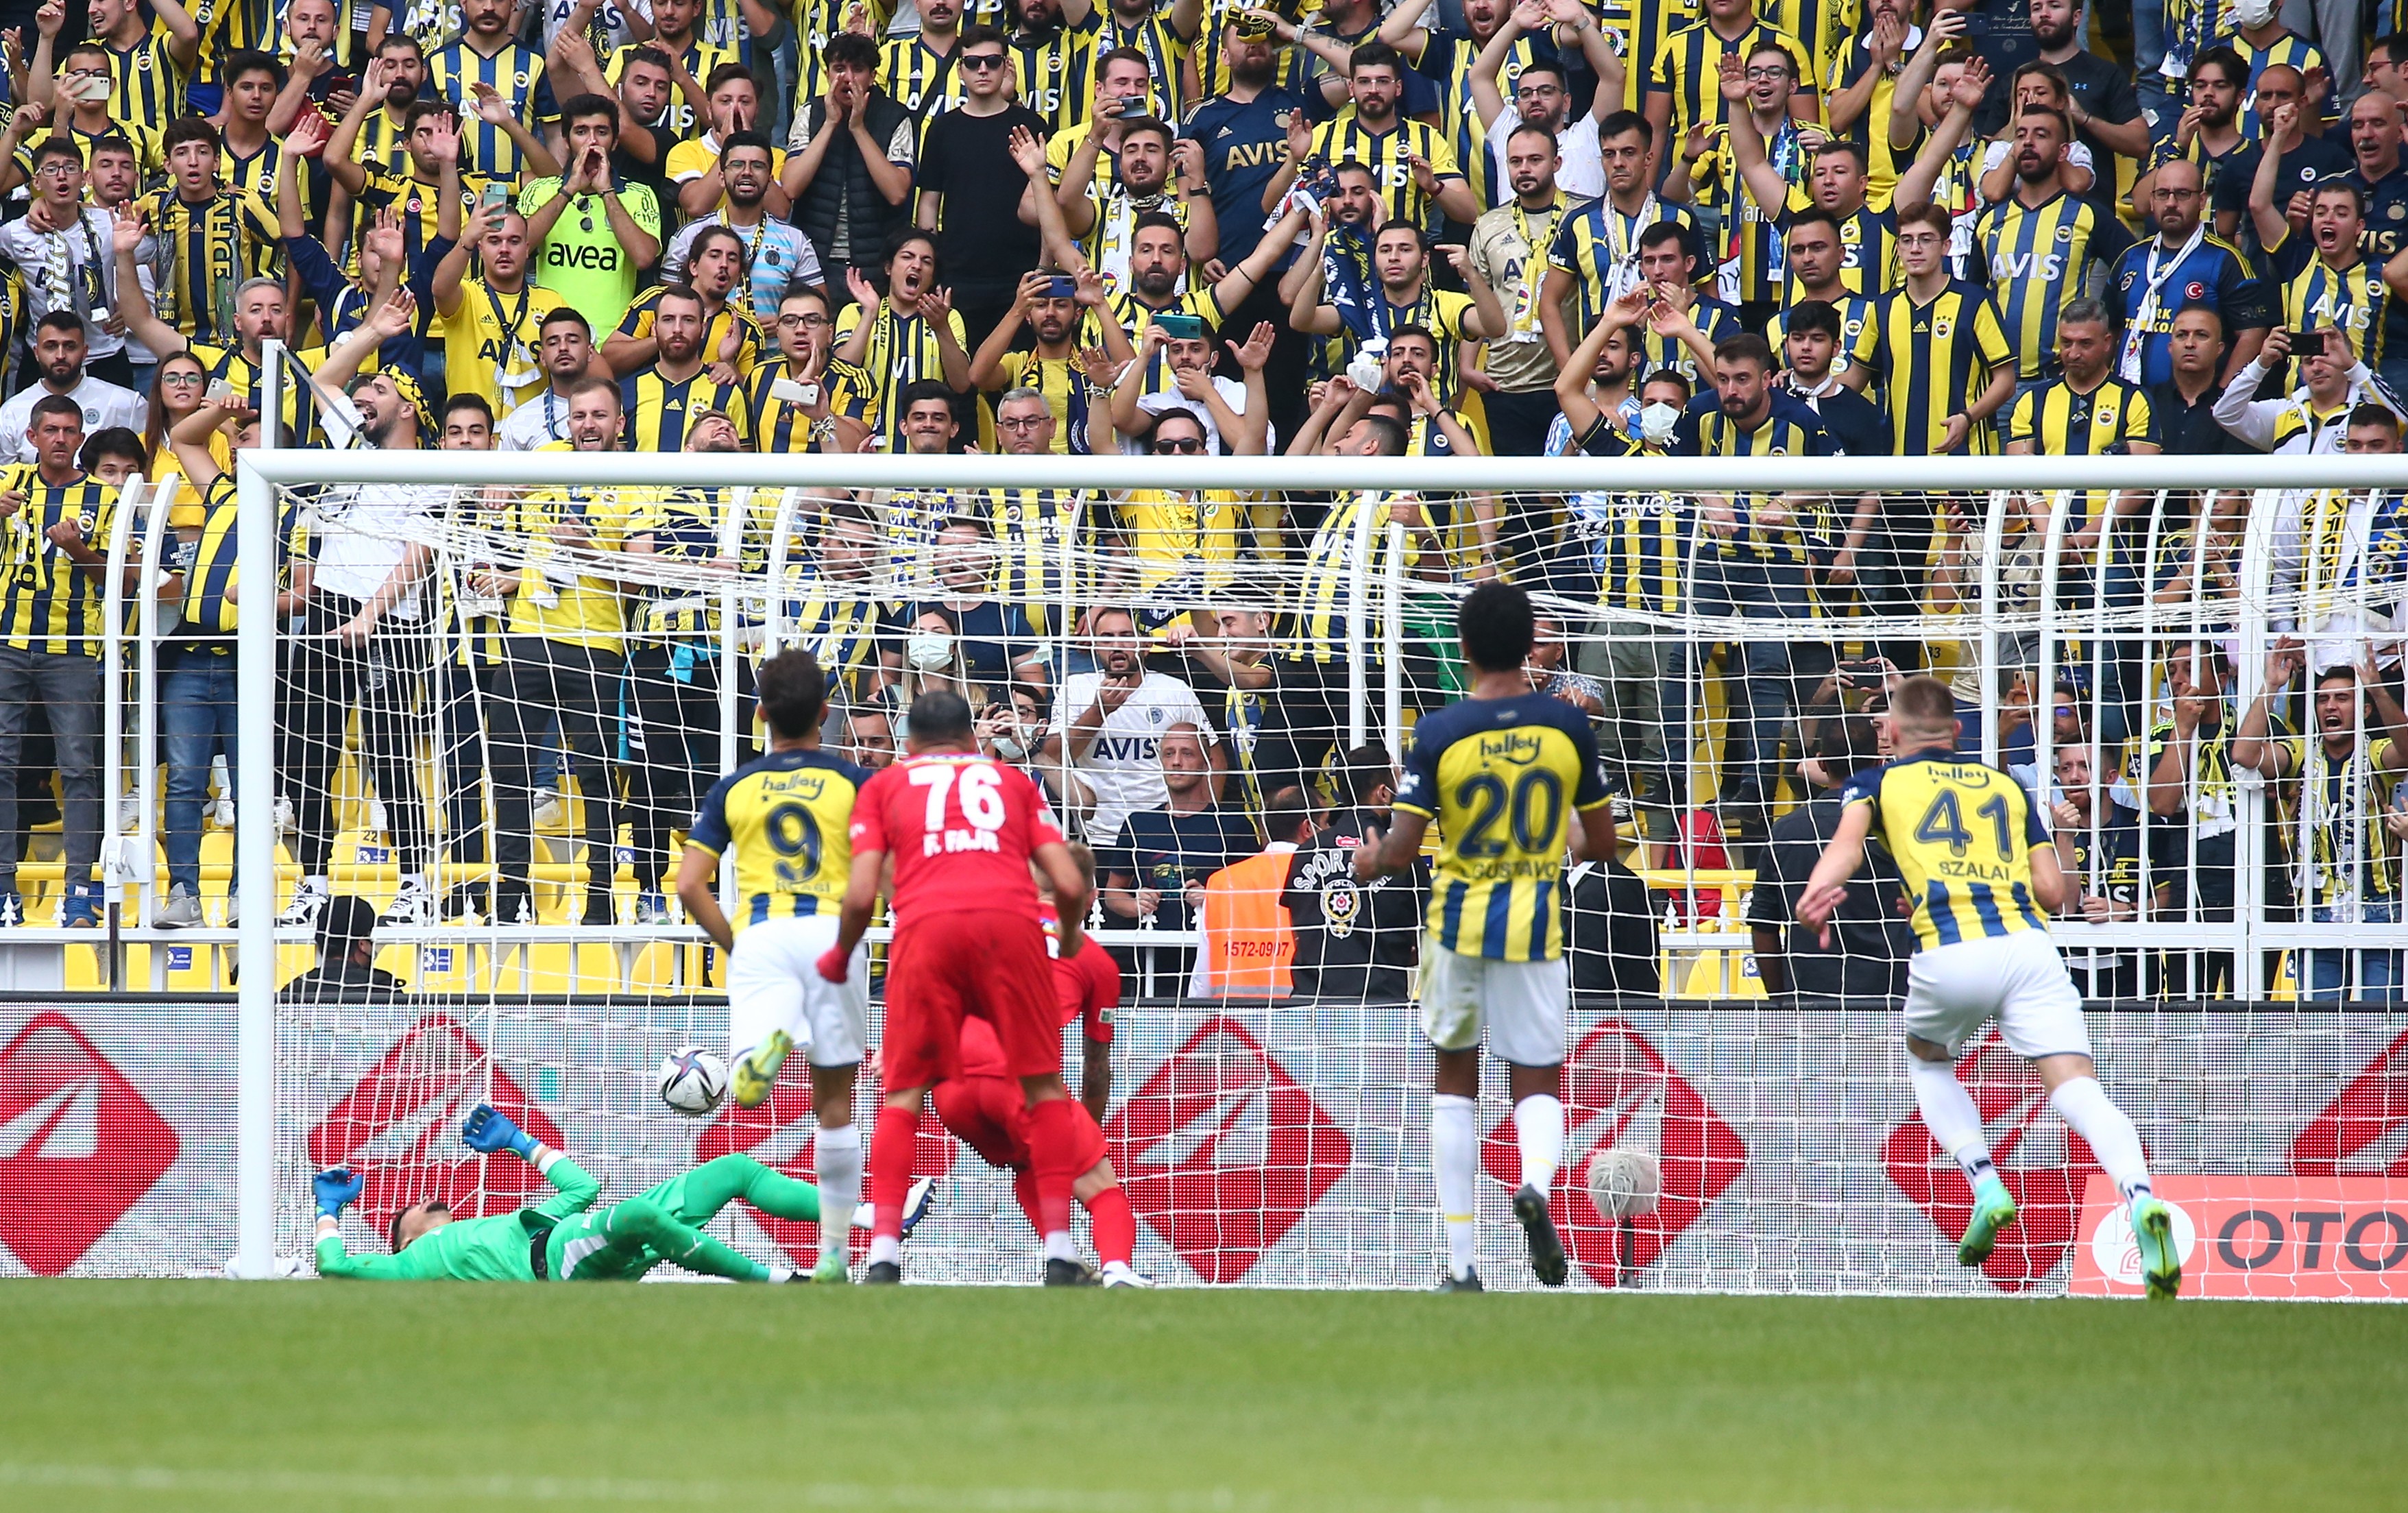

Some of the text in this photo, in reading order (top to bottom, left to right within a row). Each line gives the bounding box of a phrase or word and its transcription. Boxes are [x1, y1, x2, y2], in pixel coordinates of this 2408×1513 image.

[402, 5, 461, 32] AS
[1226, 139, 1289, 171] AVIS
[546, 242, 616, 273] avea
[1991, 252, 2063, 282] AVIS
[2309, 293, 2372, 330] AVIS
[880, 314, 889, 350] Yatar
[1619, 495, 1685, 518] avea
[1093, 738, 1158, 761] AVIS
[1480, 734, 1541, 765] halley
[762, 775, 825, 801] halley
[1927, 765, 1991, 789] halley
[905, 764, 1006, 832] 76
[1454, 768, 1561, 856] 20
[363, 830, 378, 843] 22
[1915, 789, 2012, 863] 41
[765, 802, 823, 883] 9
[923, 828, 1000, 857] F. FAJR
[1295, 849, 1345, 891] SPOR
[1473, 861, 1558, 880] GUSTAVO
[1942, 861, 2010, 882] SZALAI
[1223, 940, 1290, 958] 1572-0907
[2217, 1209, 2408, 1271] OTO
